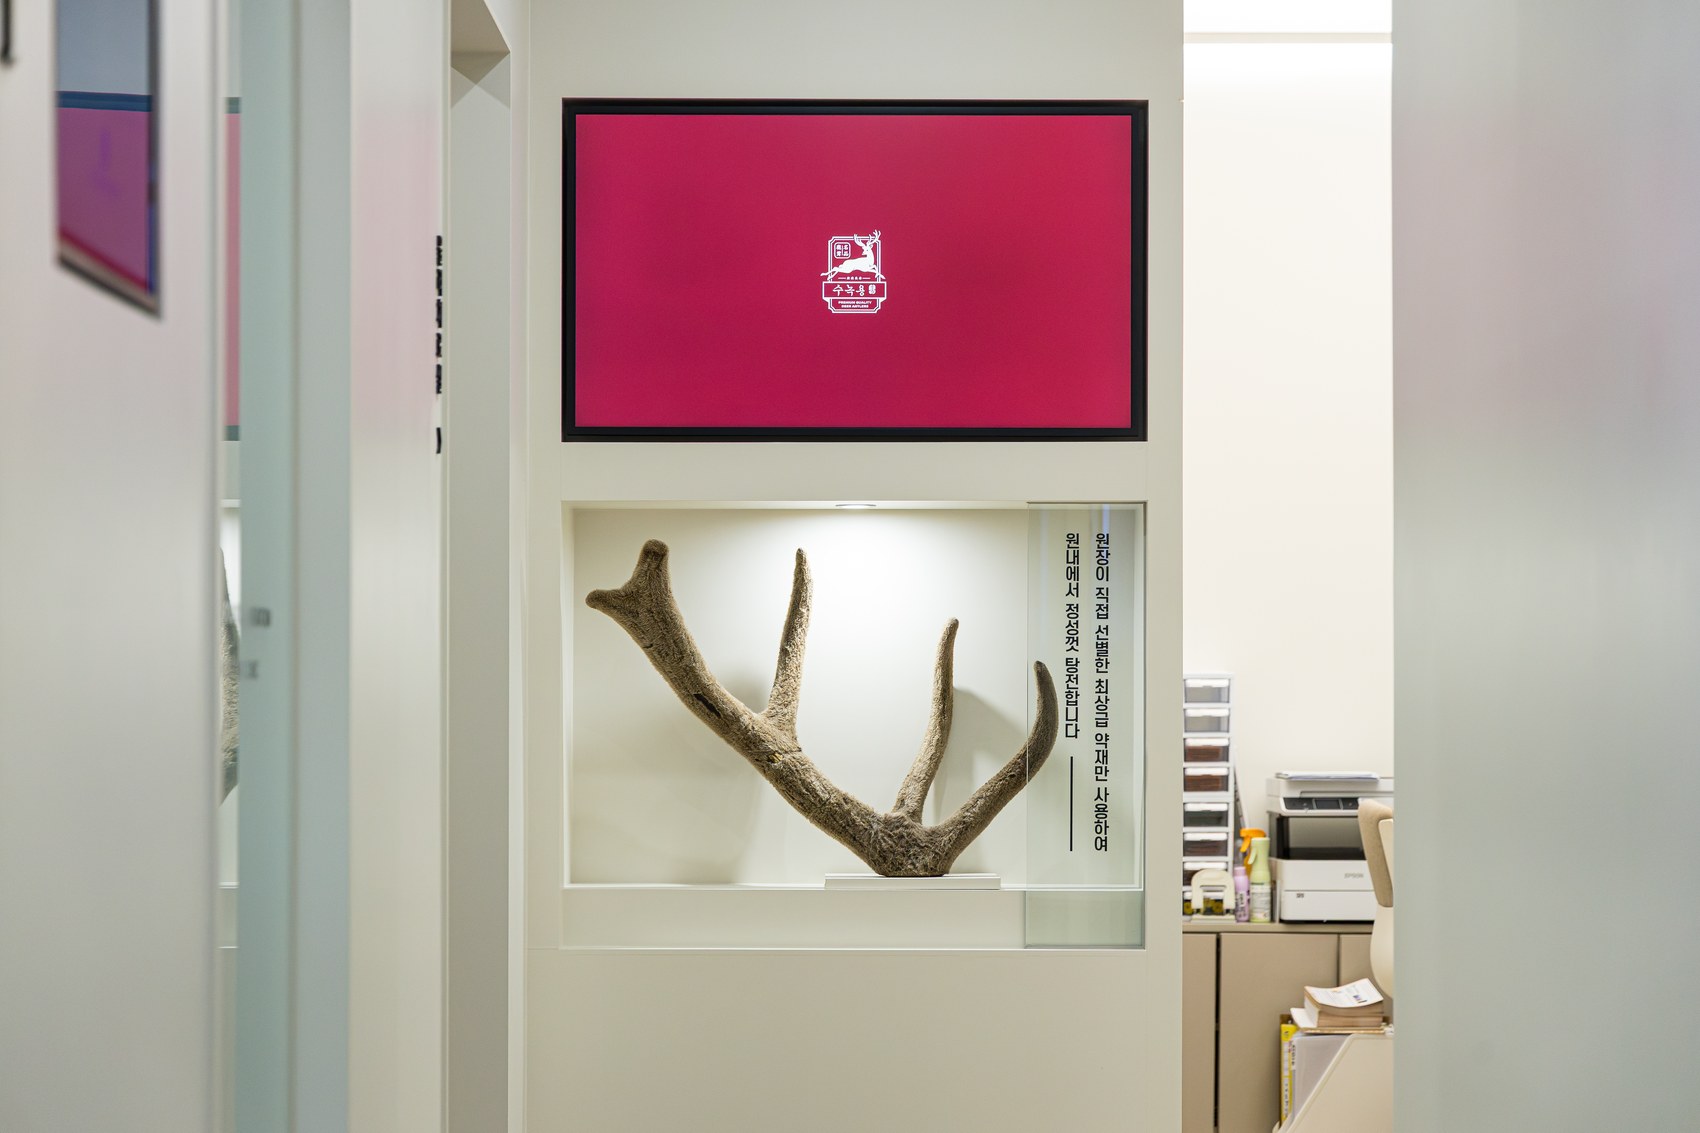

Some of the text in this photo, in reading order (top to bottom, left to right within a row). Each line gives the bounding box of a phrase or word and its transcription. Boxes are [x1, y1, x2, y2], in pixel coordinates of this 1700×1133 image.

[833, 284, 865, 296] 수녹용
[1065, 532, 1081, 739] 원내에서 정성껏 탕전합니다
[1093, 532, 1111, 852] 원장이 직접 선별한 최상급 약재만 사용하여
